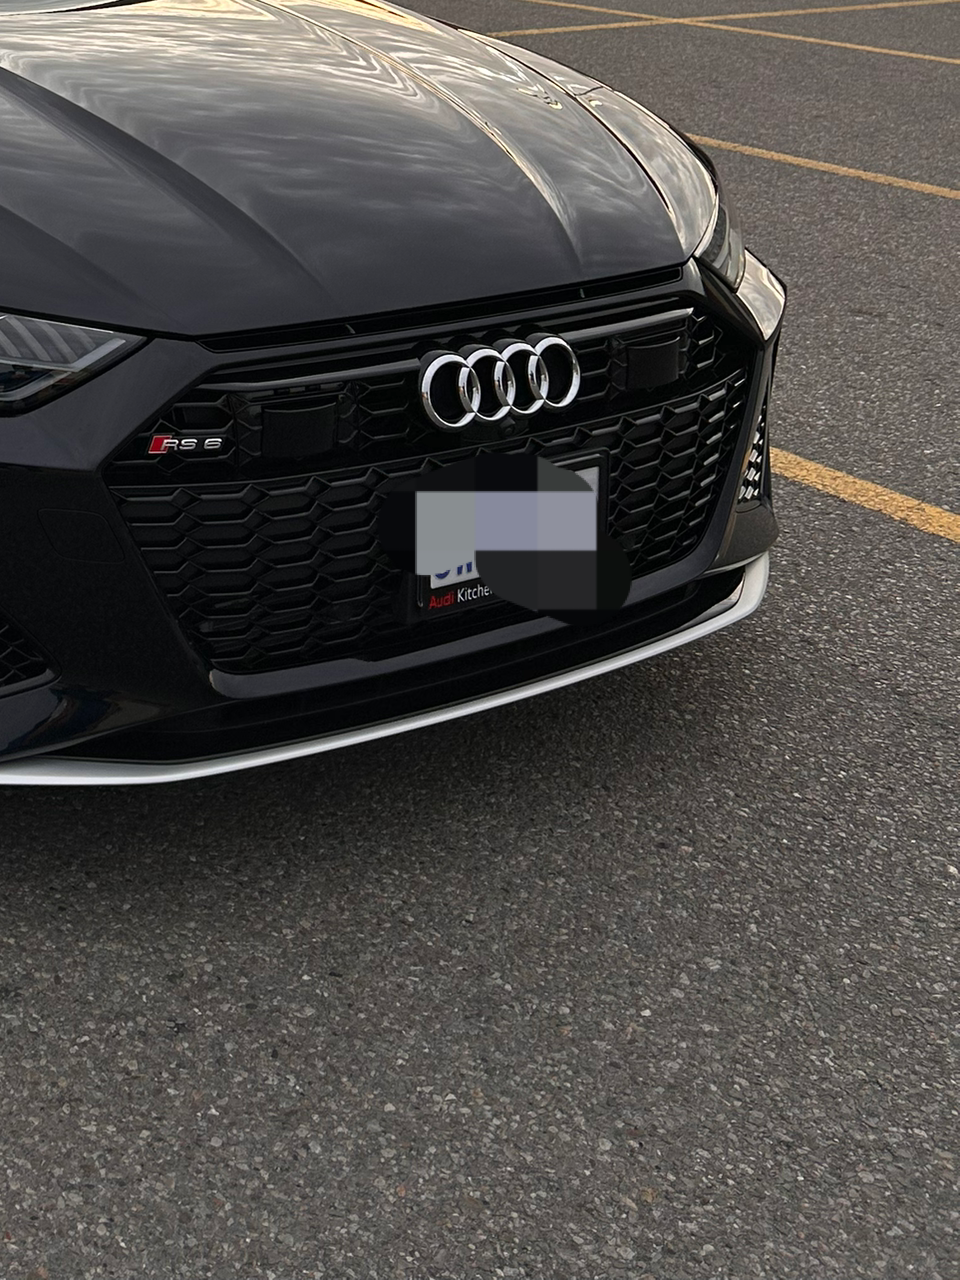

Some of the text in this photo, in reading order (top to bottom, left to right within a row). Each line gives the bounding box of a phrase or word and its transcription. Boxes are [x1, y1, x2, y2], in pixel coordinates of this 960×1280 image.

[160, 438, 223, 451] RS 6
[428, 583, 493, 610] Audi Kitche
